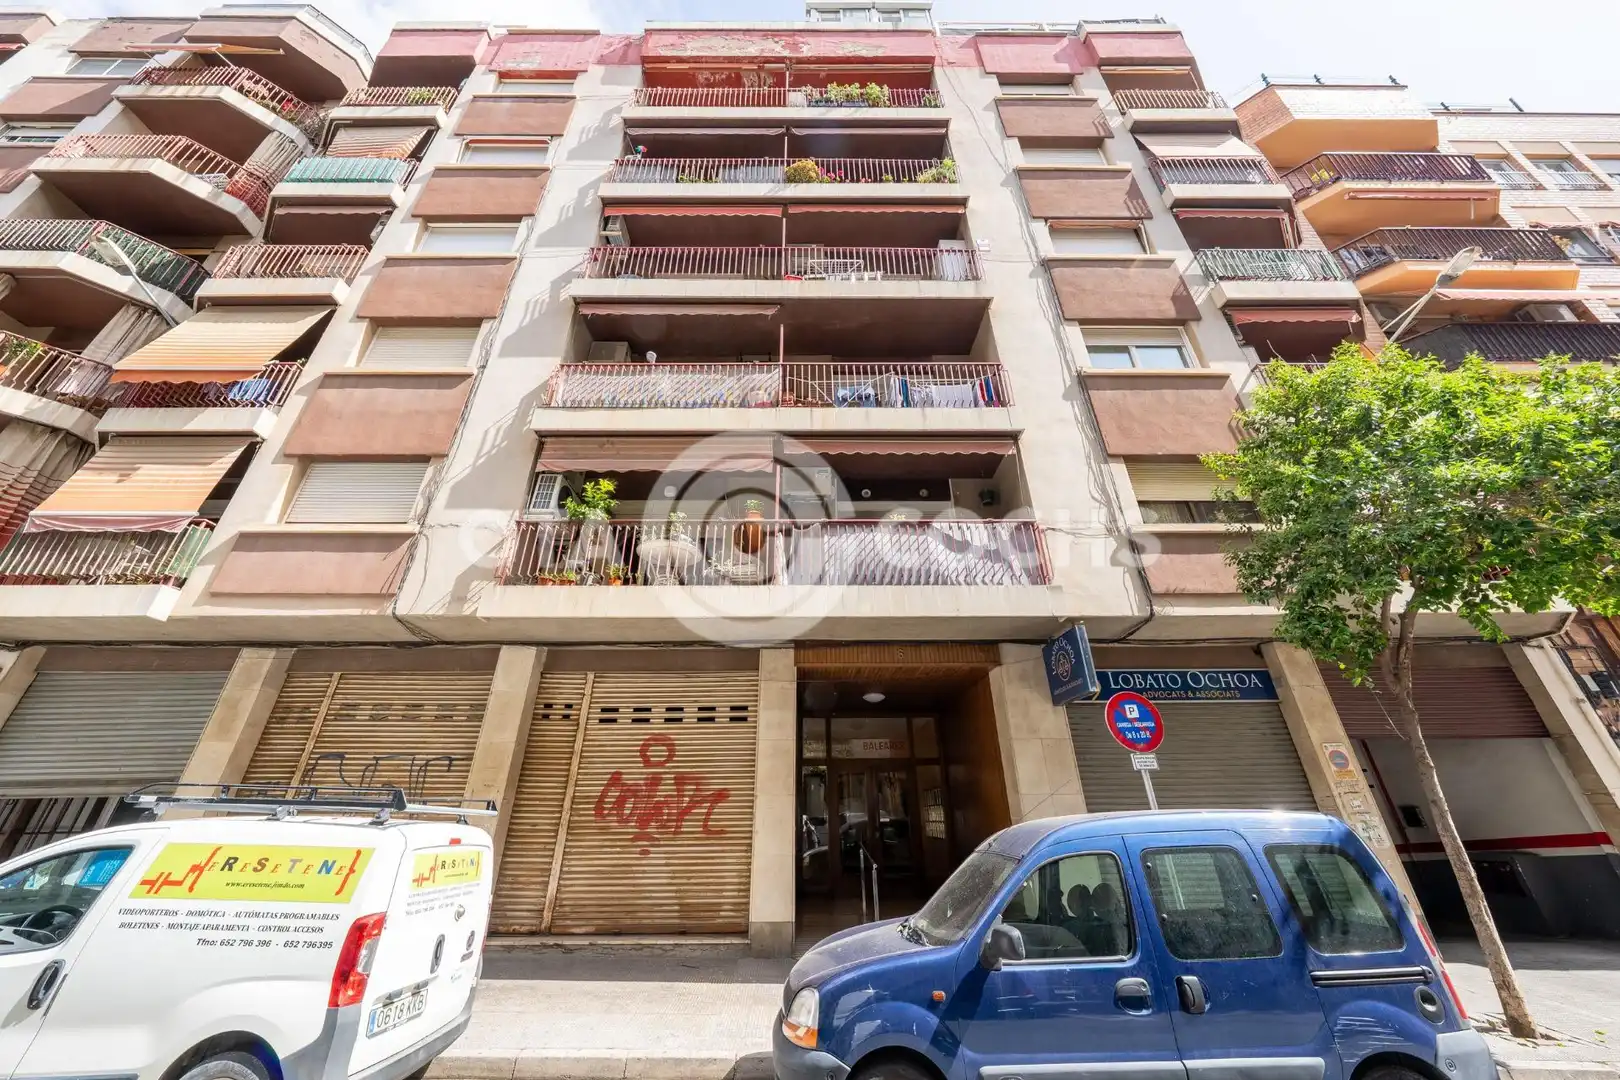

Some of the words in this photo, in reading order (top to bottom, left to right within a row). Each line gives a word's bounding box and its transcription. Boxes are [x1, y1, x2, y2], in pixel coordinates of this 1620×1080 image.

[1107, 671, 1182, 689] LOBATO
[1187, 670, 1263, 689] OCHOA
[1142, 690, 1186, 699] ADVOCATS
[1187, 690, 1194, 698] &
[1195, 690, 1241, 698] ASSOCIATS
[1128, 706, 1135, 716] P
[118, 908, 180, 917] VIDEOPORTEROS
[185, 909, 226, 918] DOMÓTICA
[232, 910, 279, 920] AUTÓMATAS
[279, 912, 341, 921] PROGRAMABLES
[118, 922, 161, 930] BOLETINES
[166, 923, 201, 931] MONTAJE
[201, 924, 250, 932] APARAMENTA
[257, 925, 291, 933] CONTROL
[292, 926, 325, 934] ACCESOS
[196, 938, 218, 946] Tfno:
[219, 939, 237, 947] 652
[237, 940, 254, 948] 796
[255, 940, 272, 948] 396
[283, 940, 300, 949] 652
[376, 1002, 405, 1029] 0618
[406, 994, 424, 1016] KKB
